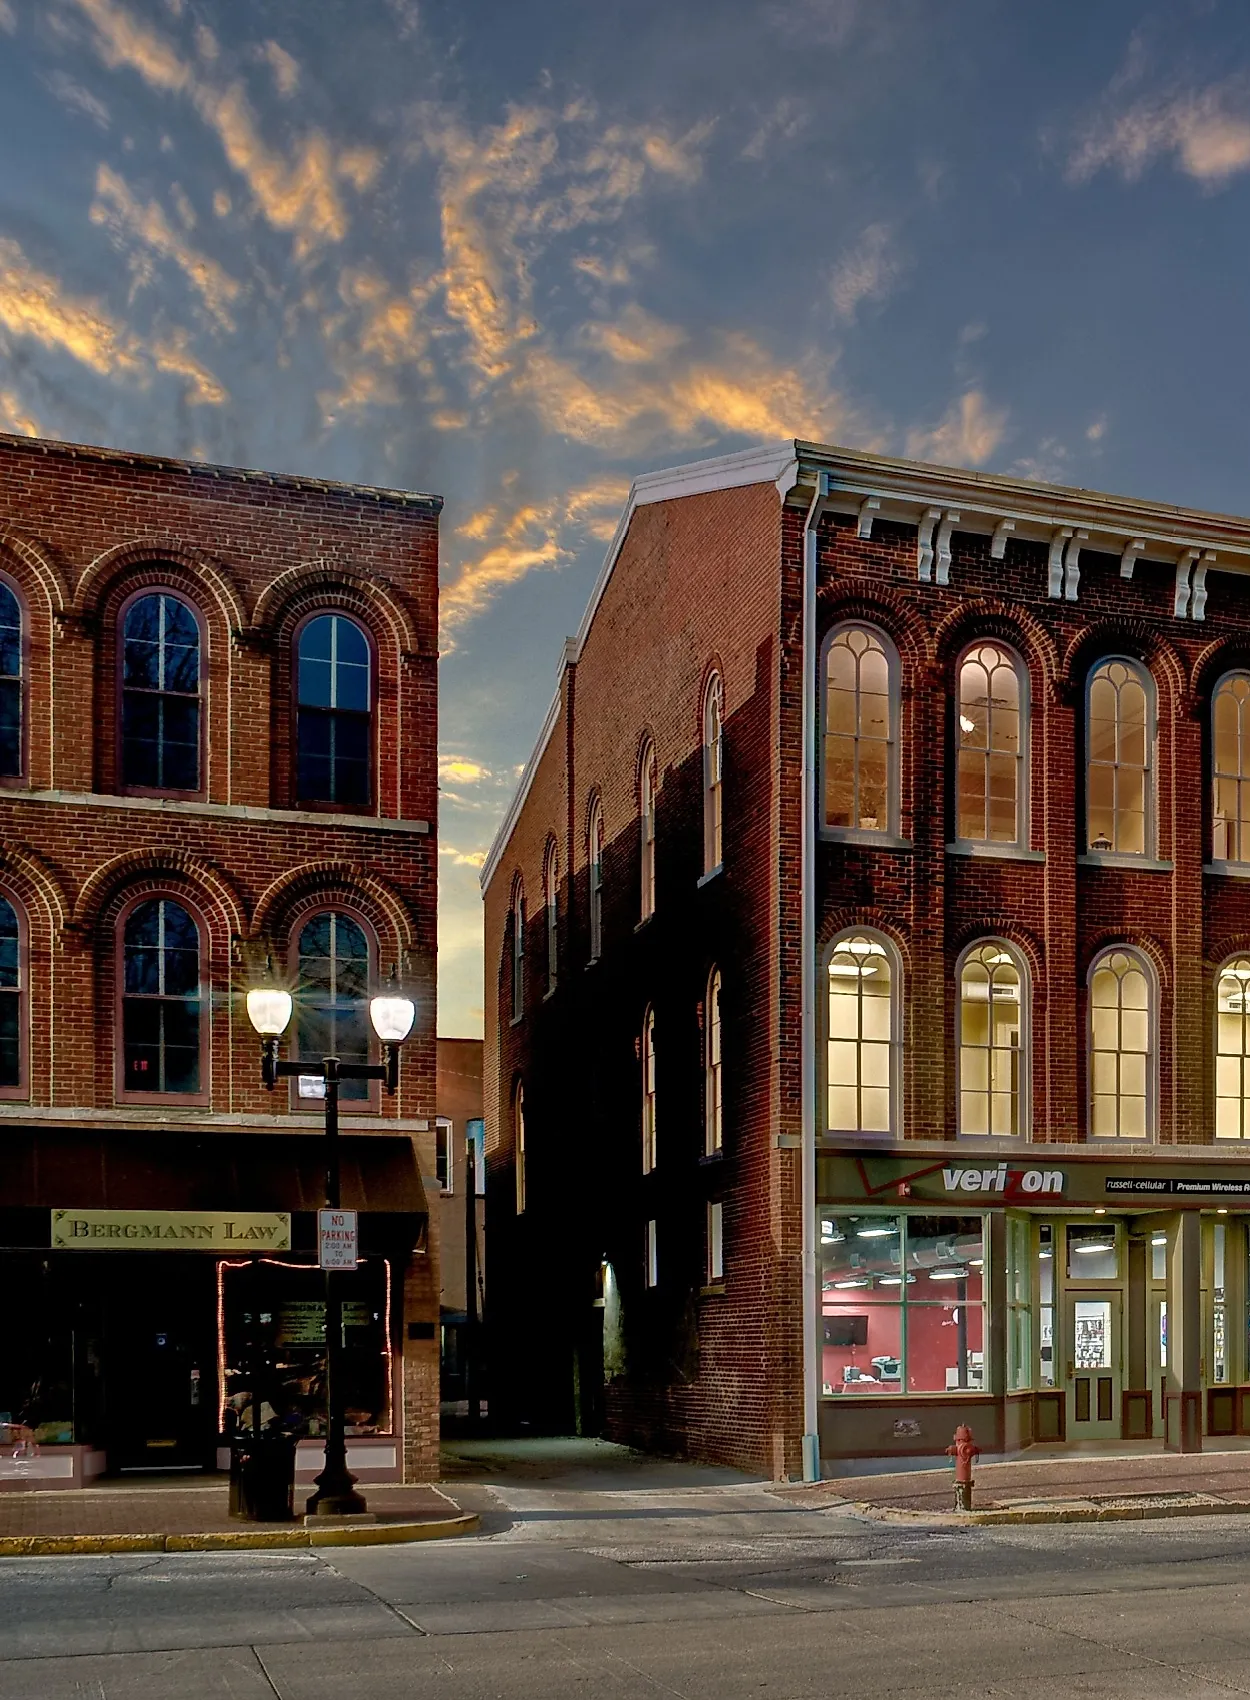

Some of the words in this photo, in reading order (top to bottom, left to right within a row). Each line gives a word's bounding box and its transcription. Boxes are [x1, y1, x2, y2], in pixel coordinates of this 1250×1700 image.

[942, 1162, 1064, 1199] verizon
[1176, 1182, 1211, 1191] Premium
[1211, 1182, 1243, 1192] Wireless
[331, 1215, 345, 1227] NO
[68, 1220, 214, 1239] BERGMANN
[223, 1222, 279, 1240] LAW
[321, 1229, 356, 1242] PARKING
